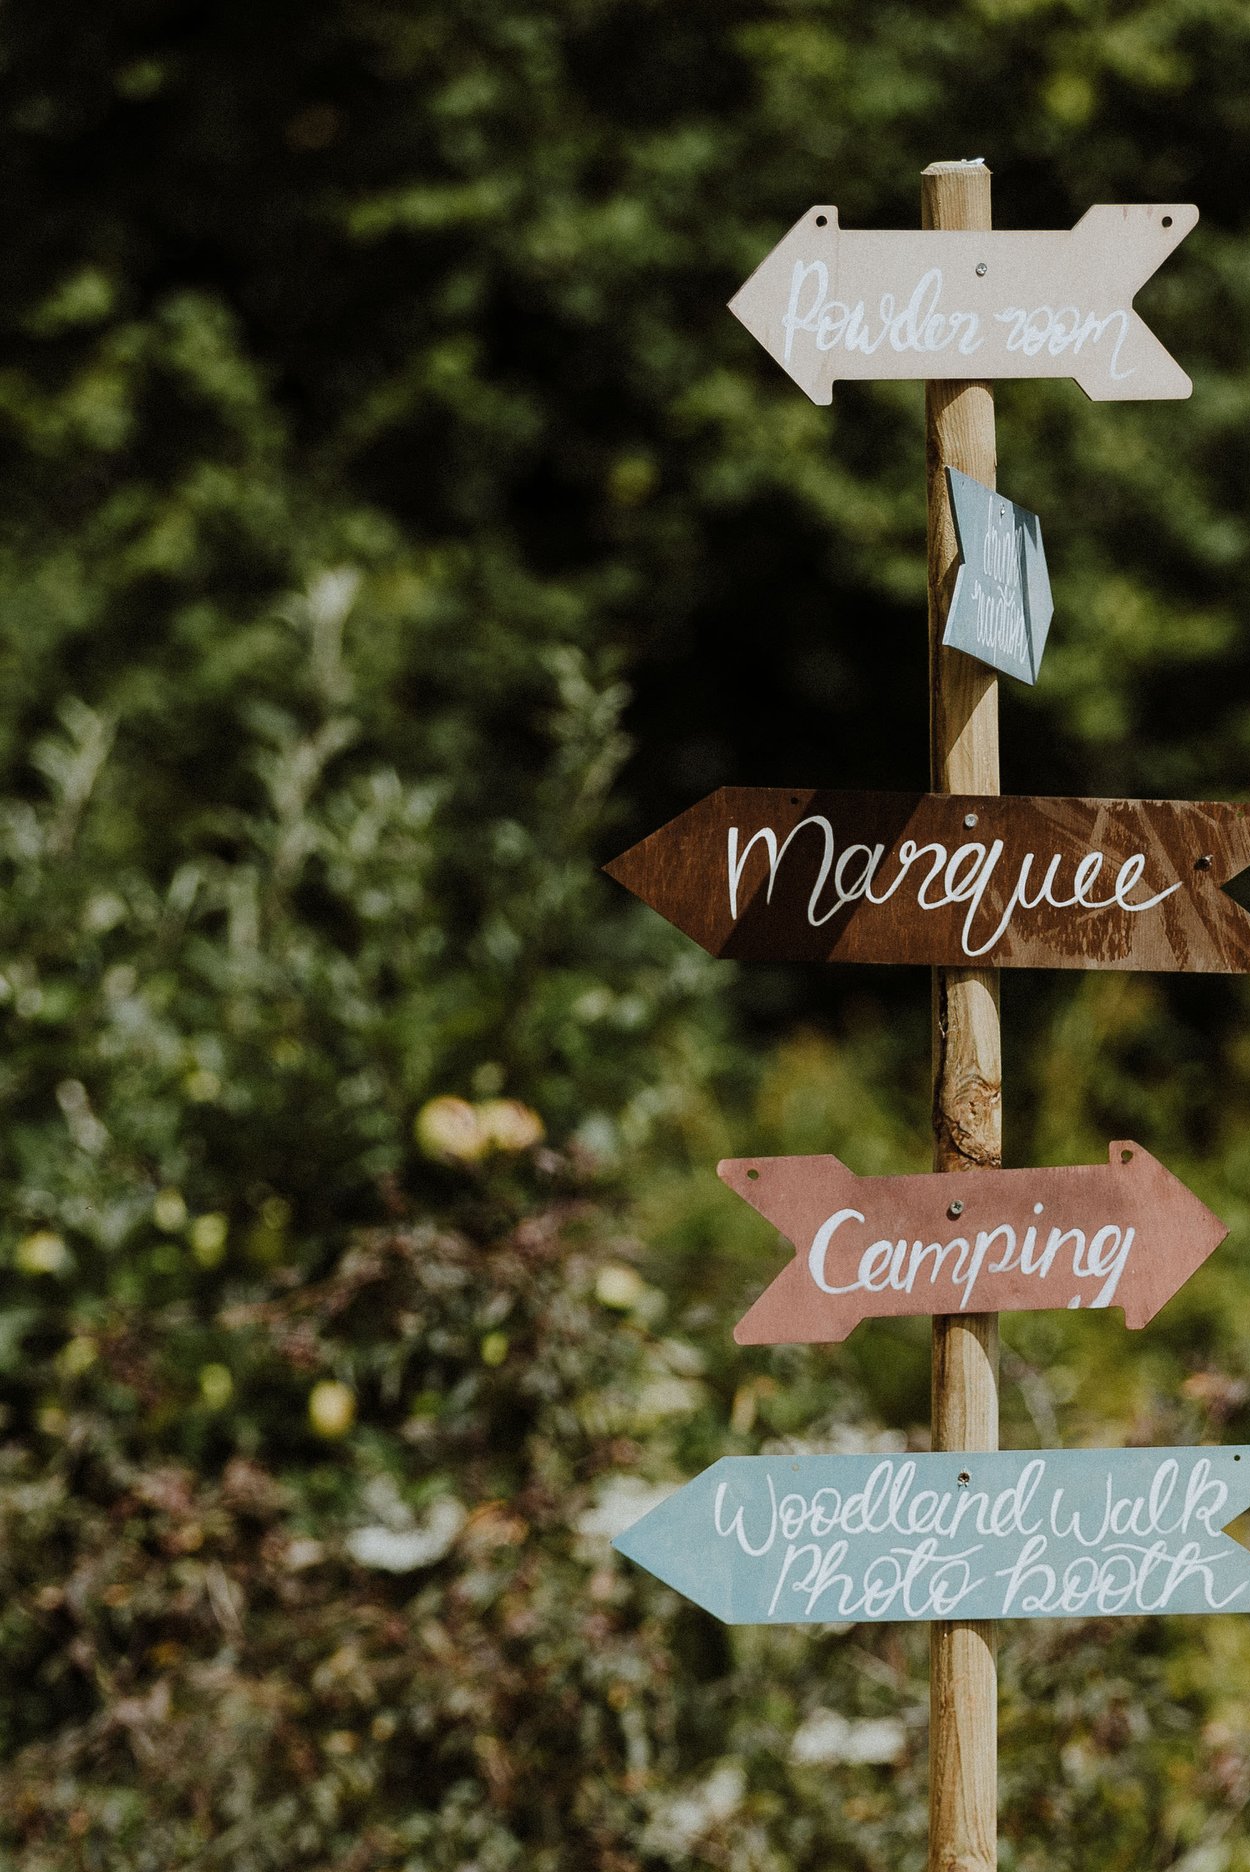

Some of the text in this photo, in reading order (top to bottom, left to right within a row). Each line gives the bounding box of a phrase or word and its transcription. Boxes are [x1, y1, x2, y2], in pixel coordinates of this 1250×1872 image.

[782, 259, 1135, 380] Powder room
[728, 815, 1183, 957] Marquee
[808, 1207, 1136, 1309] Camping
[714, 1458, 1046, 1556] Woodland
[995, 1535, 1249, 1614] booth
